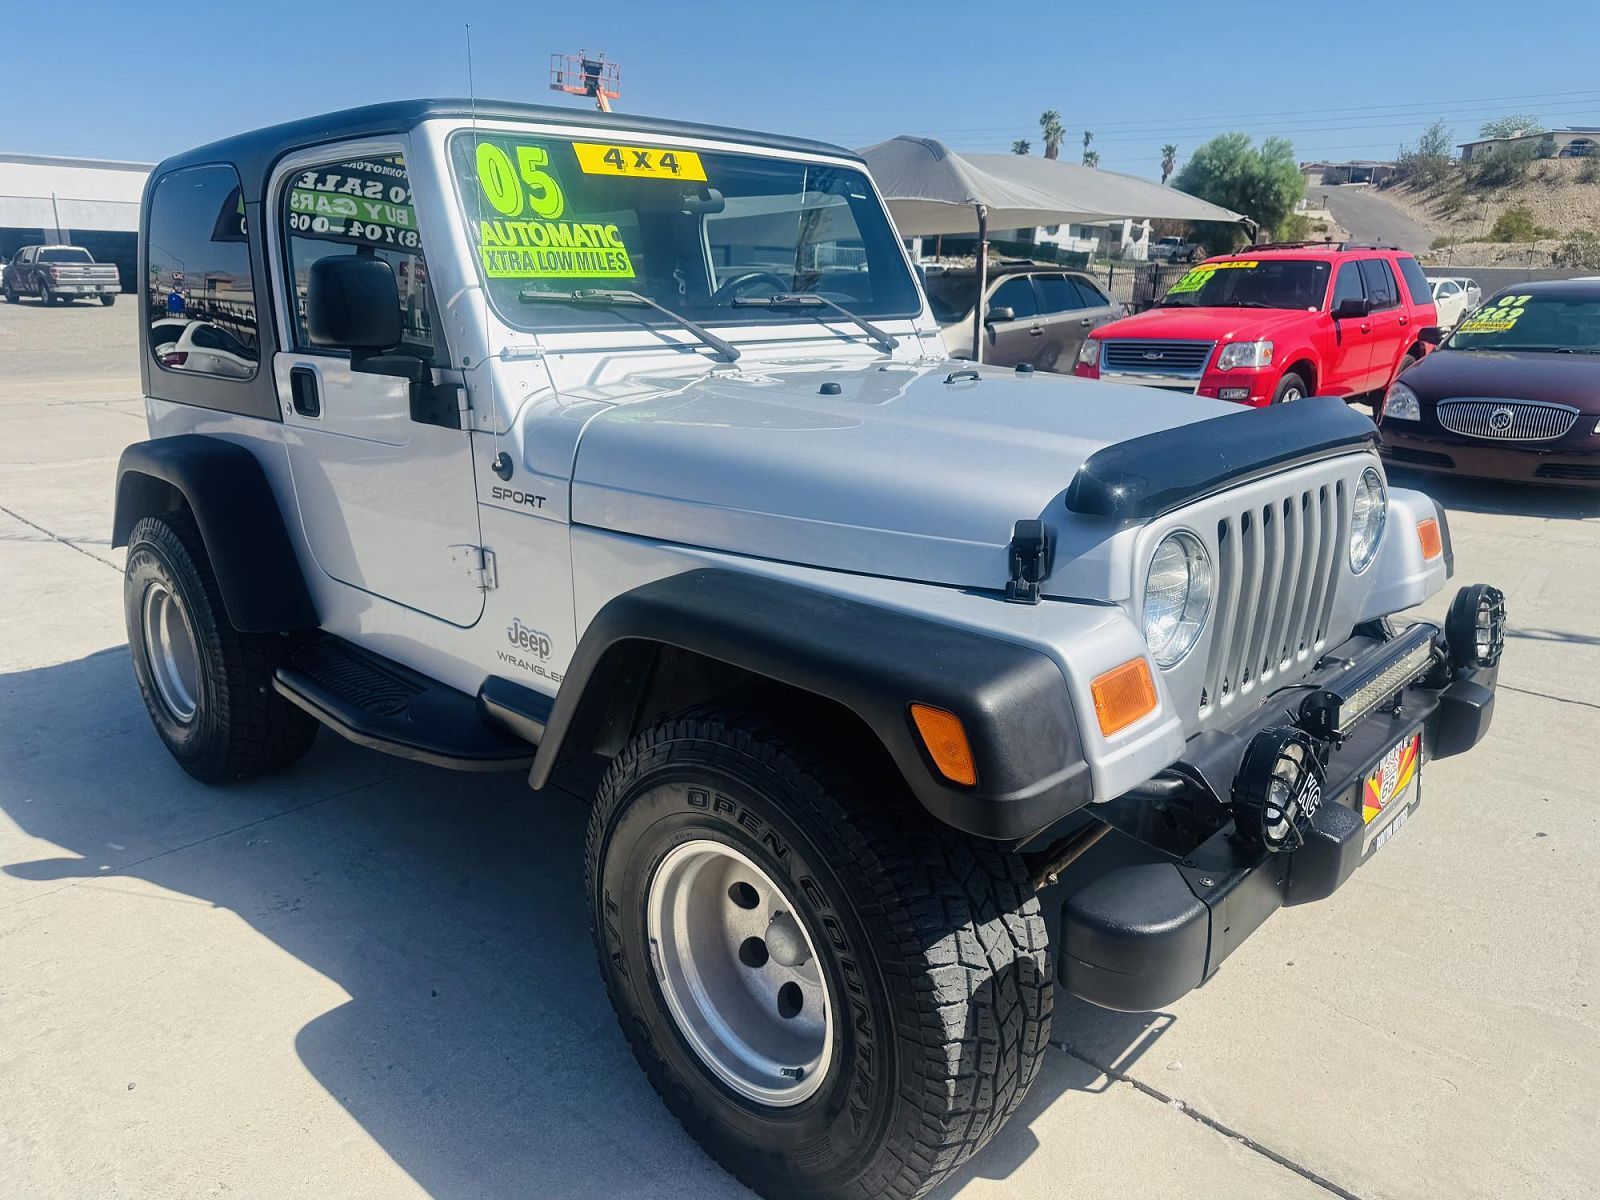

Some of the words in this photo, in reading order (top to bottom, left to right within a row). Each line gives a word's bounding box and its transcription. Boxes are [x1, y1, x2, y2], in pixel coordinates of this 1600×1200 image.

[476, 142, 564, 219] 05
[480, 220, 625, 248] AUTOMATIC
[536, 250, 574, 271] LOW
[575, 250, 629, 272] MILES
[491, 486, 546, 509] SPORT
[508, 621, 550, 659] Jeep
[687, 787, 792, 860] OPEN
[799, 876, 875, 1136] COUNTRY
